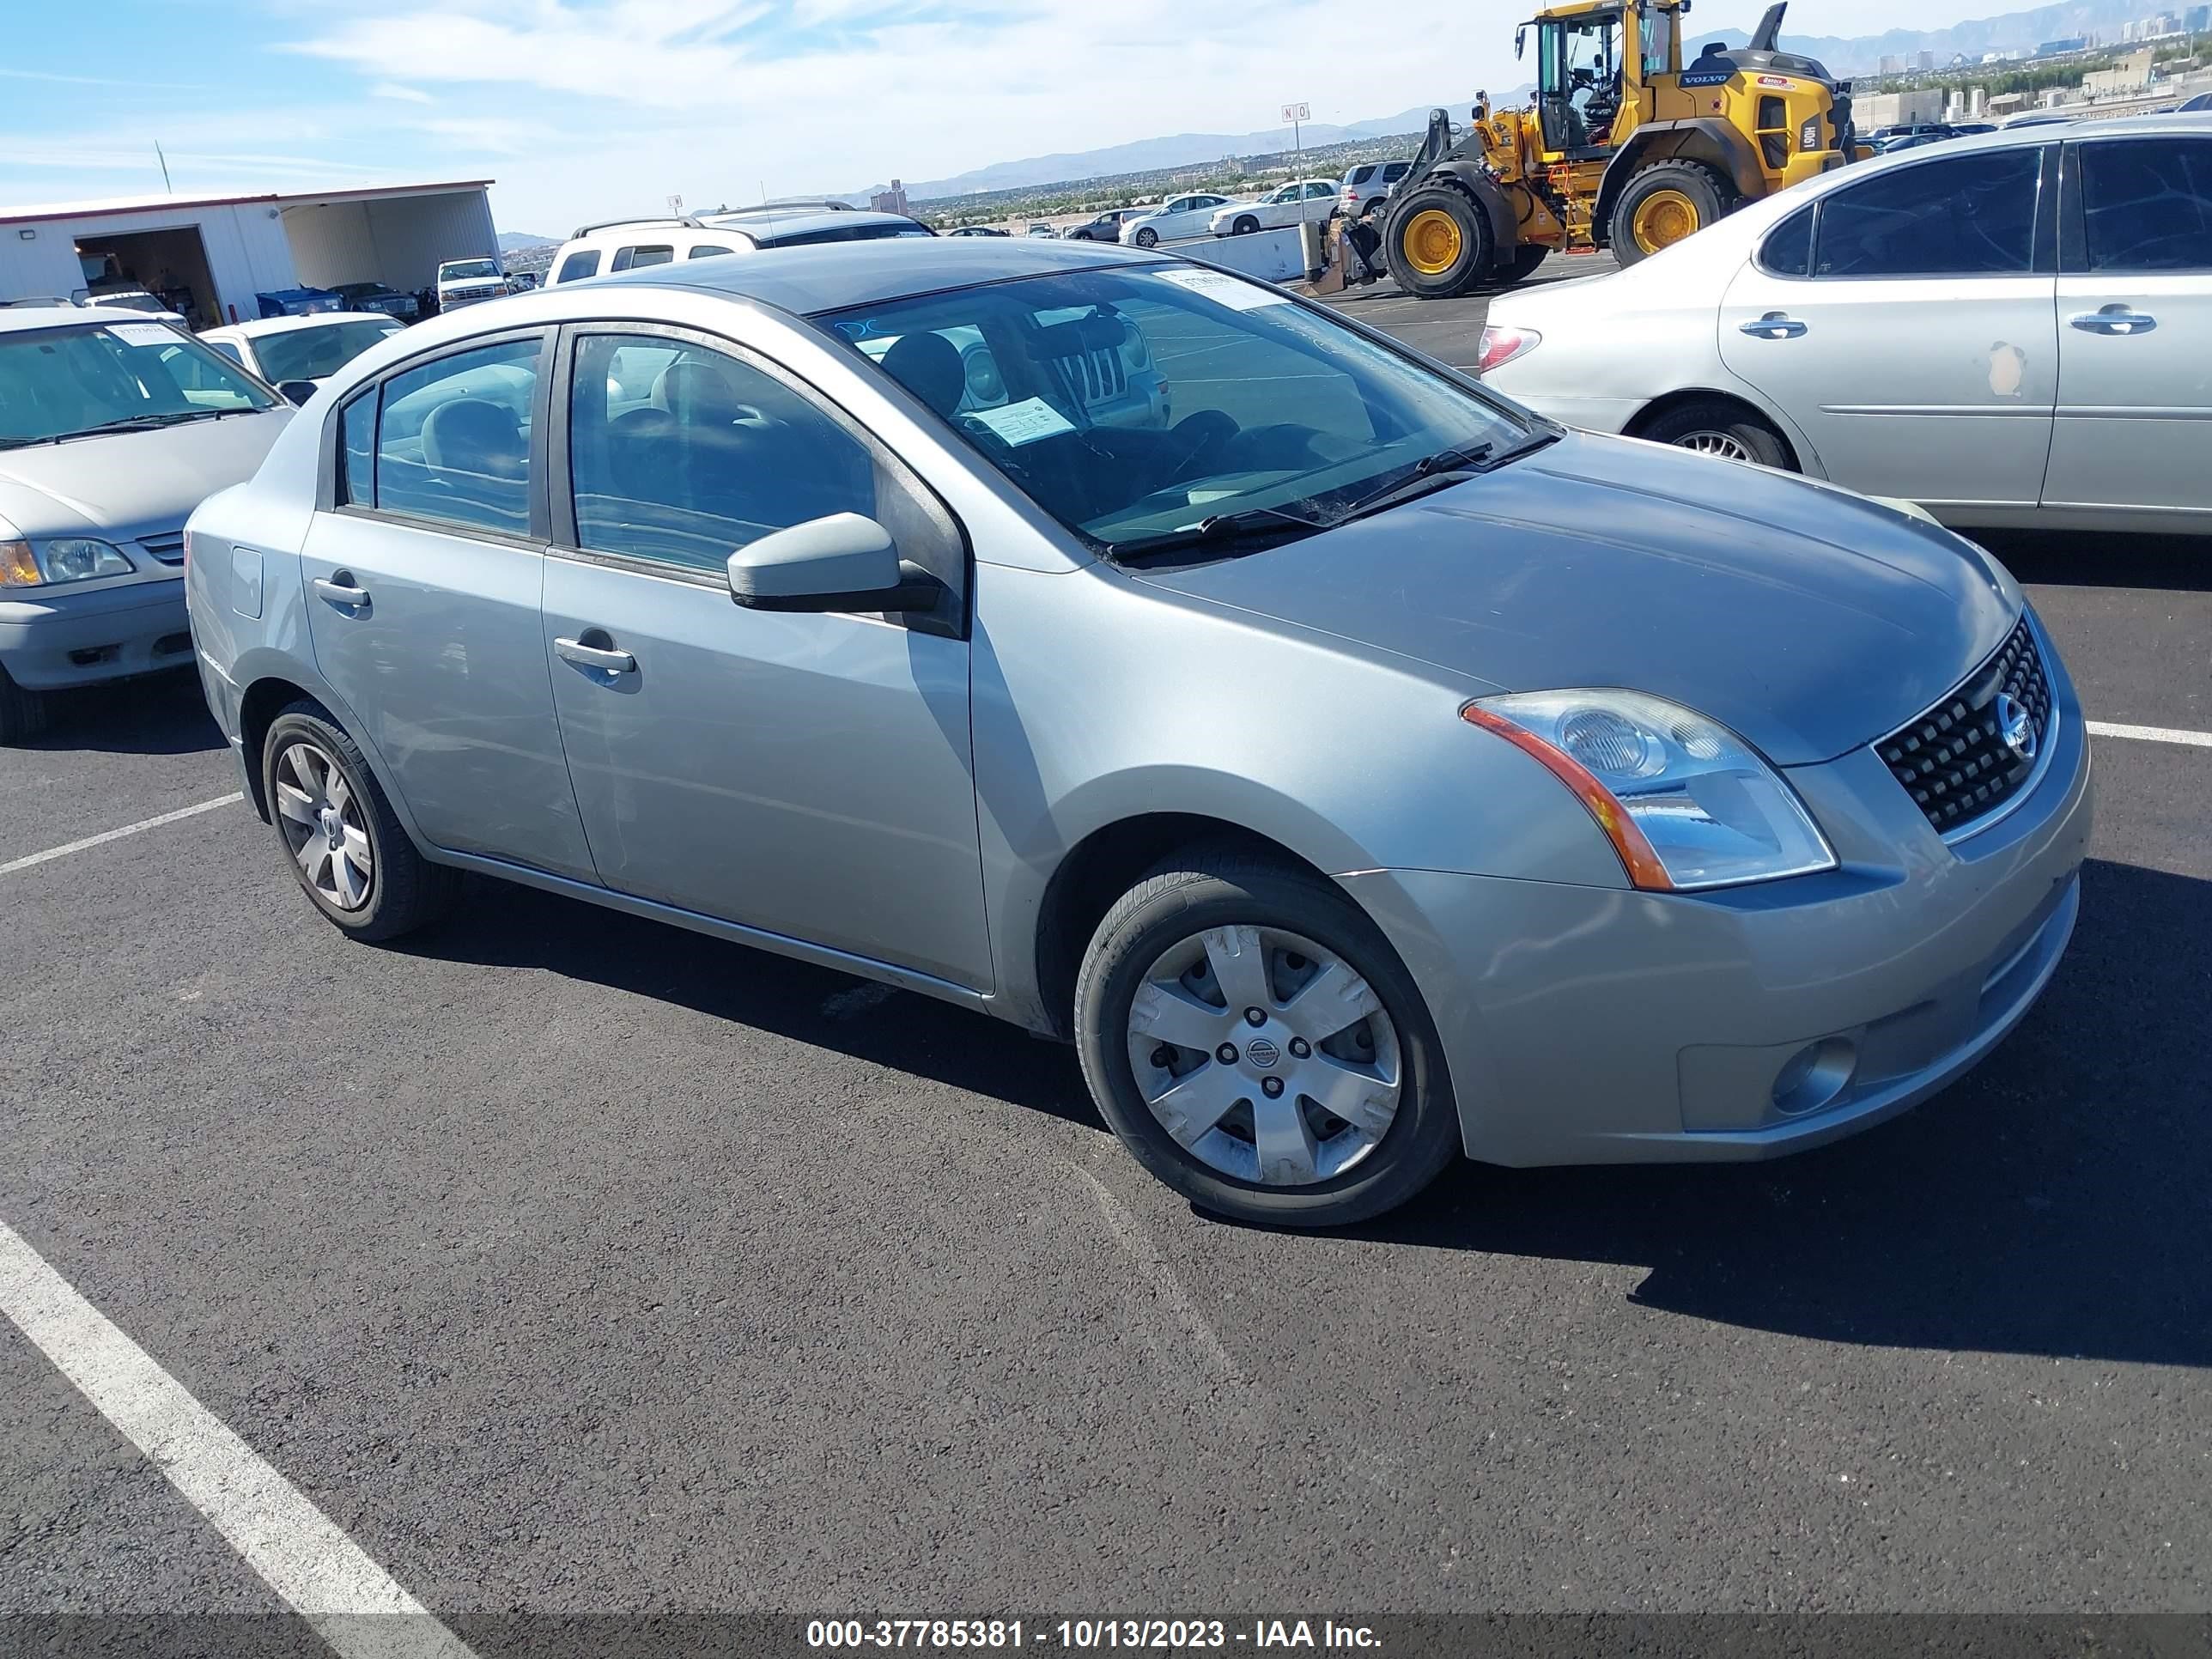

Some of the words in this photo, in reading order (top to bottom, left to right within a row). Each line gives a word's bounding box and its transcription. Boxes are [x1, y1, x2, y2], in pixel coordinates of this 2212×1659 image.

[1684, 75, 1728, 84] VOLVO
[1285, 107, 1291, 118] N
[1803, 126, 1816, 148] L90H
